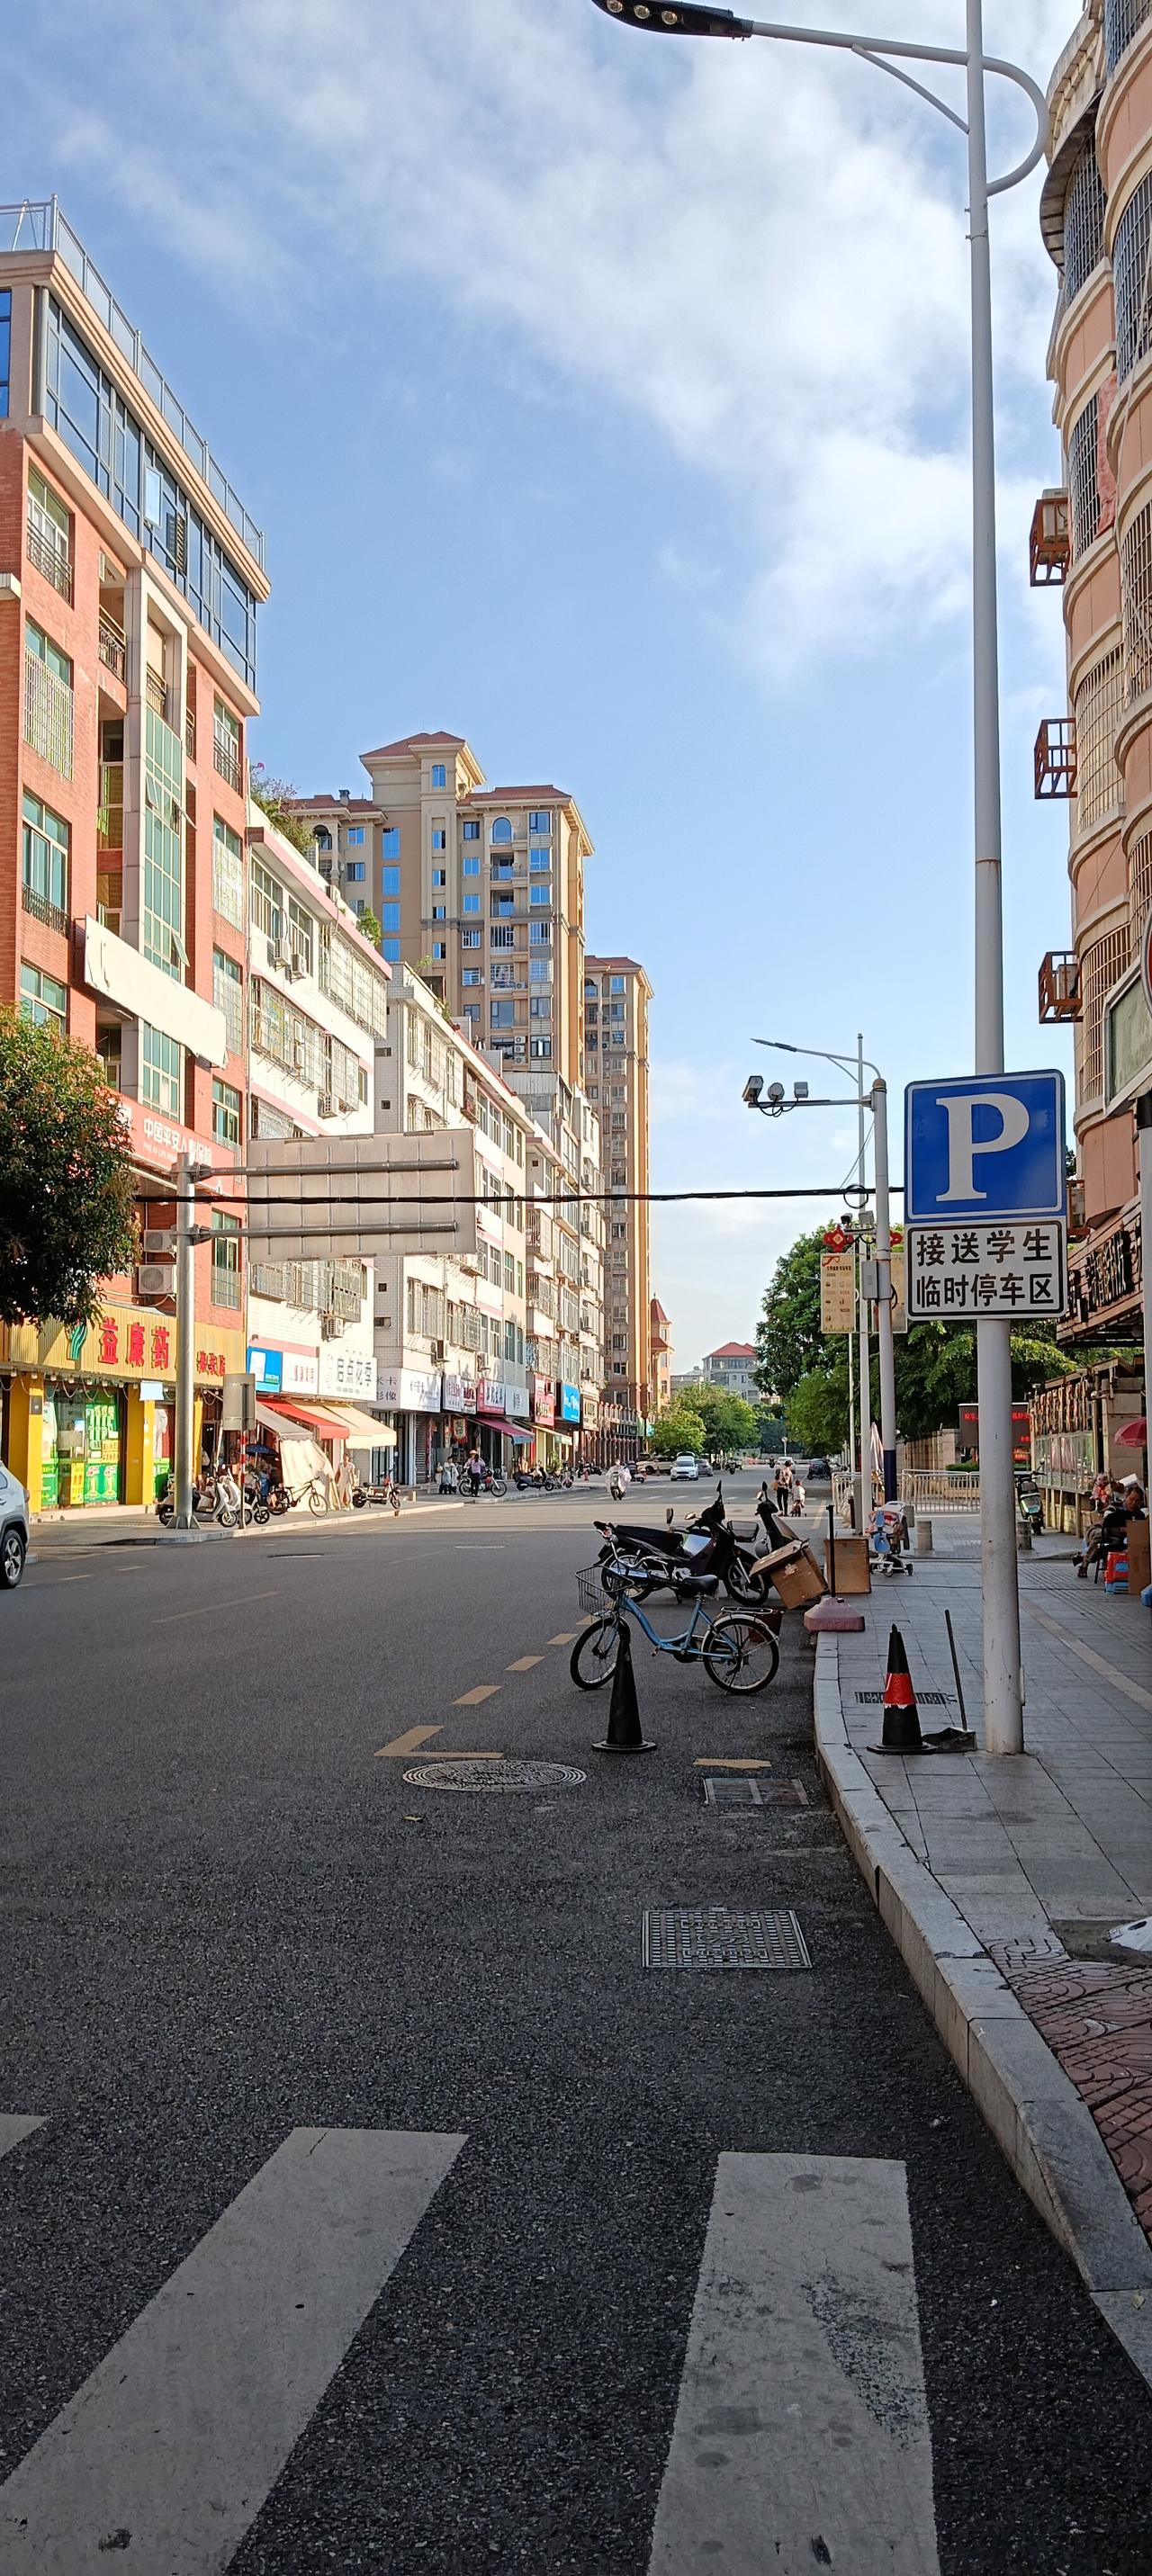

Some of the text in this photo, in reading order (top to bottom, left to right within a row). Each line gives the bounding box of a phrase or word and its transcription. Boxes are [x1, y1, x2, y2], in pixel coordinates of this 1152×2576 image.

[936, 1092, 1030, 1202] P
[916, 1228, 1052, 1267] 接送学生
[916, 1272, 1054, 1308] 临时停车区
[98, 1316, 177, 1370] 益康药
